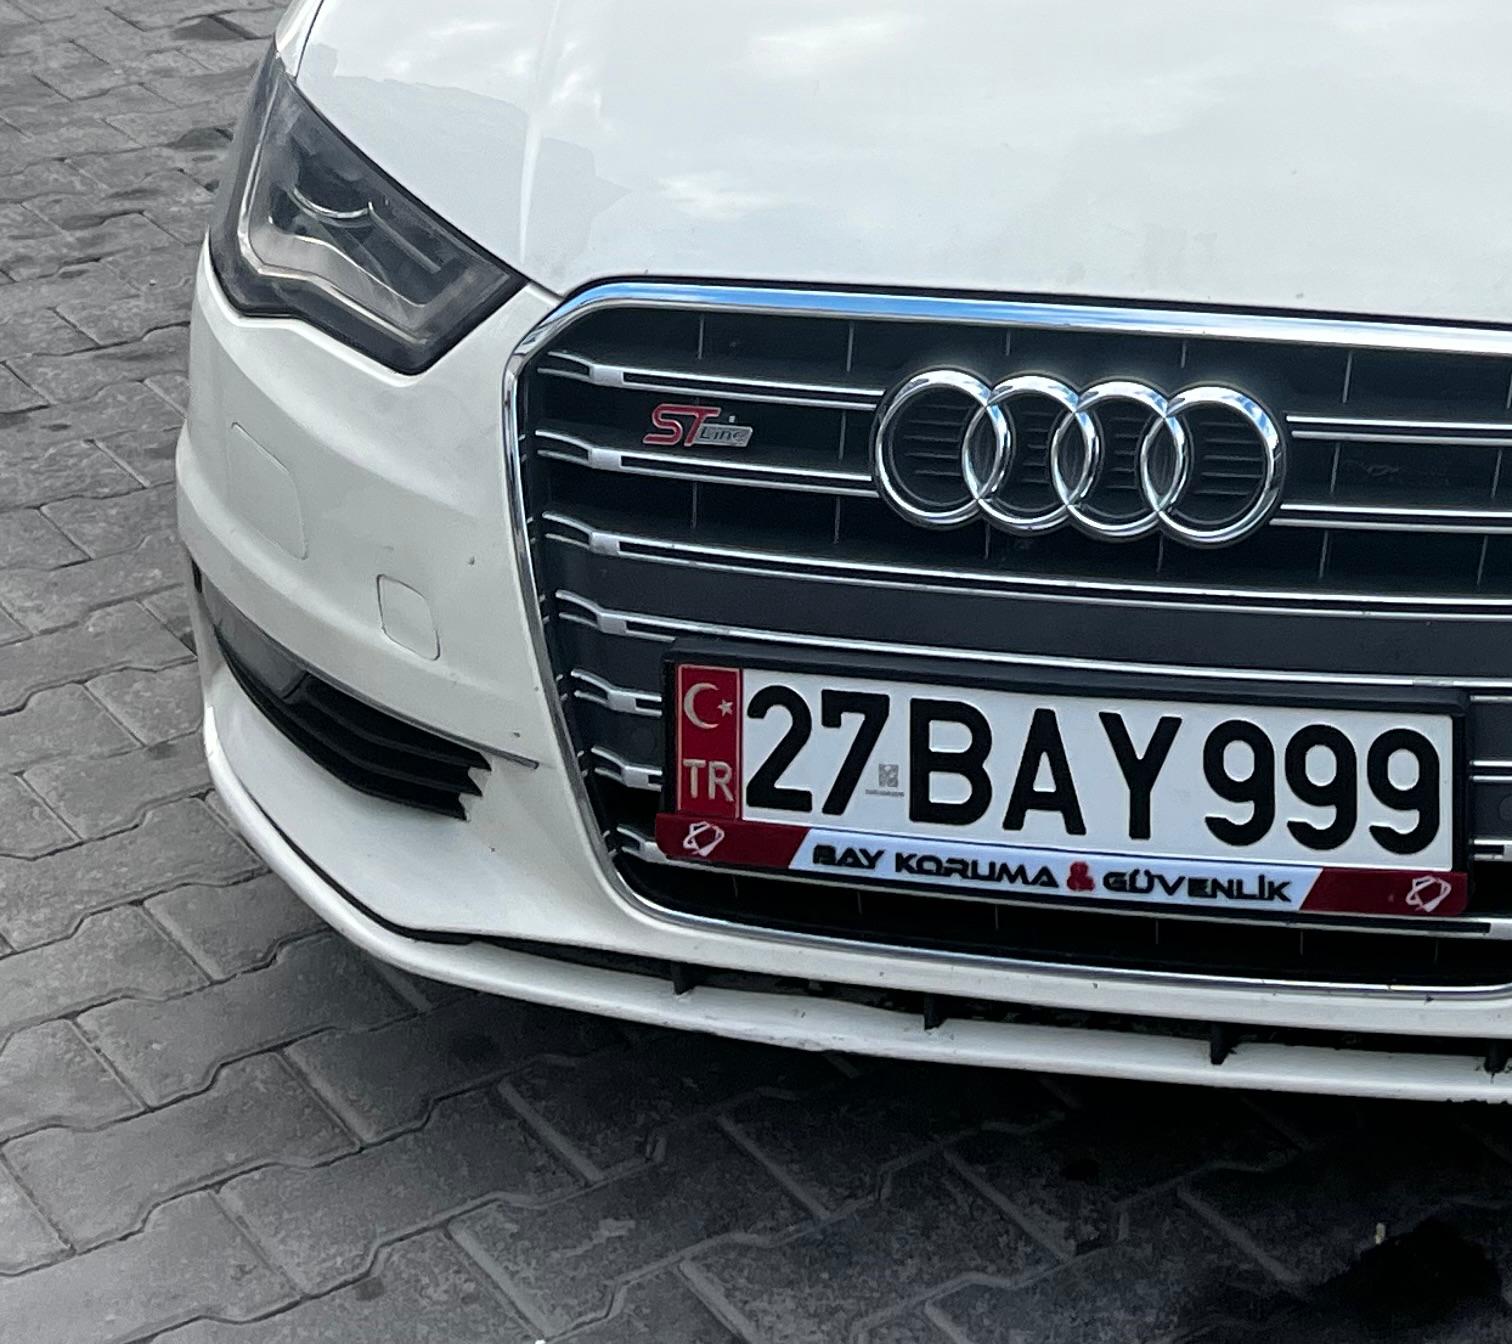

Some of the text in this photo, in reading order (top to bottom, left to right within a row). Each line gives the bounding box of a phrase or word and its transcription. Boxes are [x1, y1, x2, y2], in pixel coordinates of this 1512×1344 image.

[643, 403, 721, 447] ST
[682, 758, 735, 803] TR
[812, 843, 1293, 903] BAY KORUMA & GÜVENLİK
